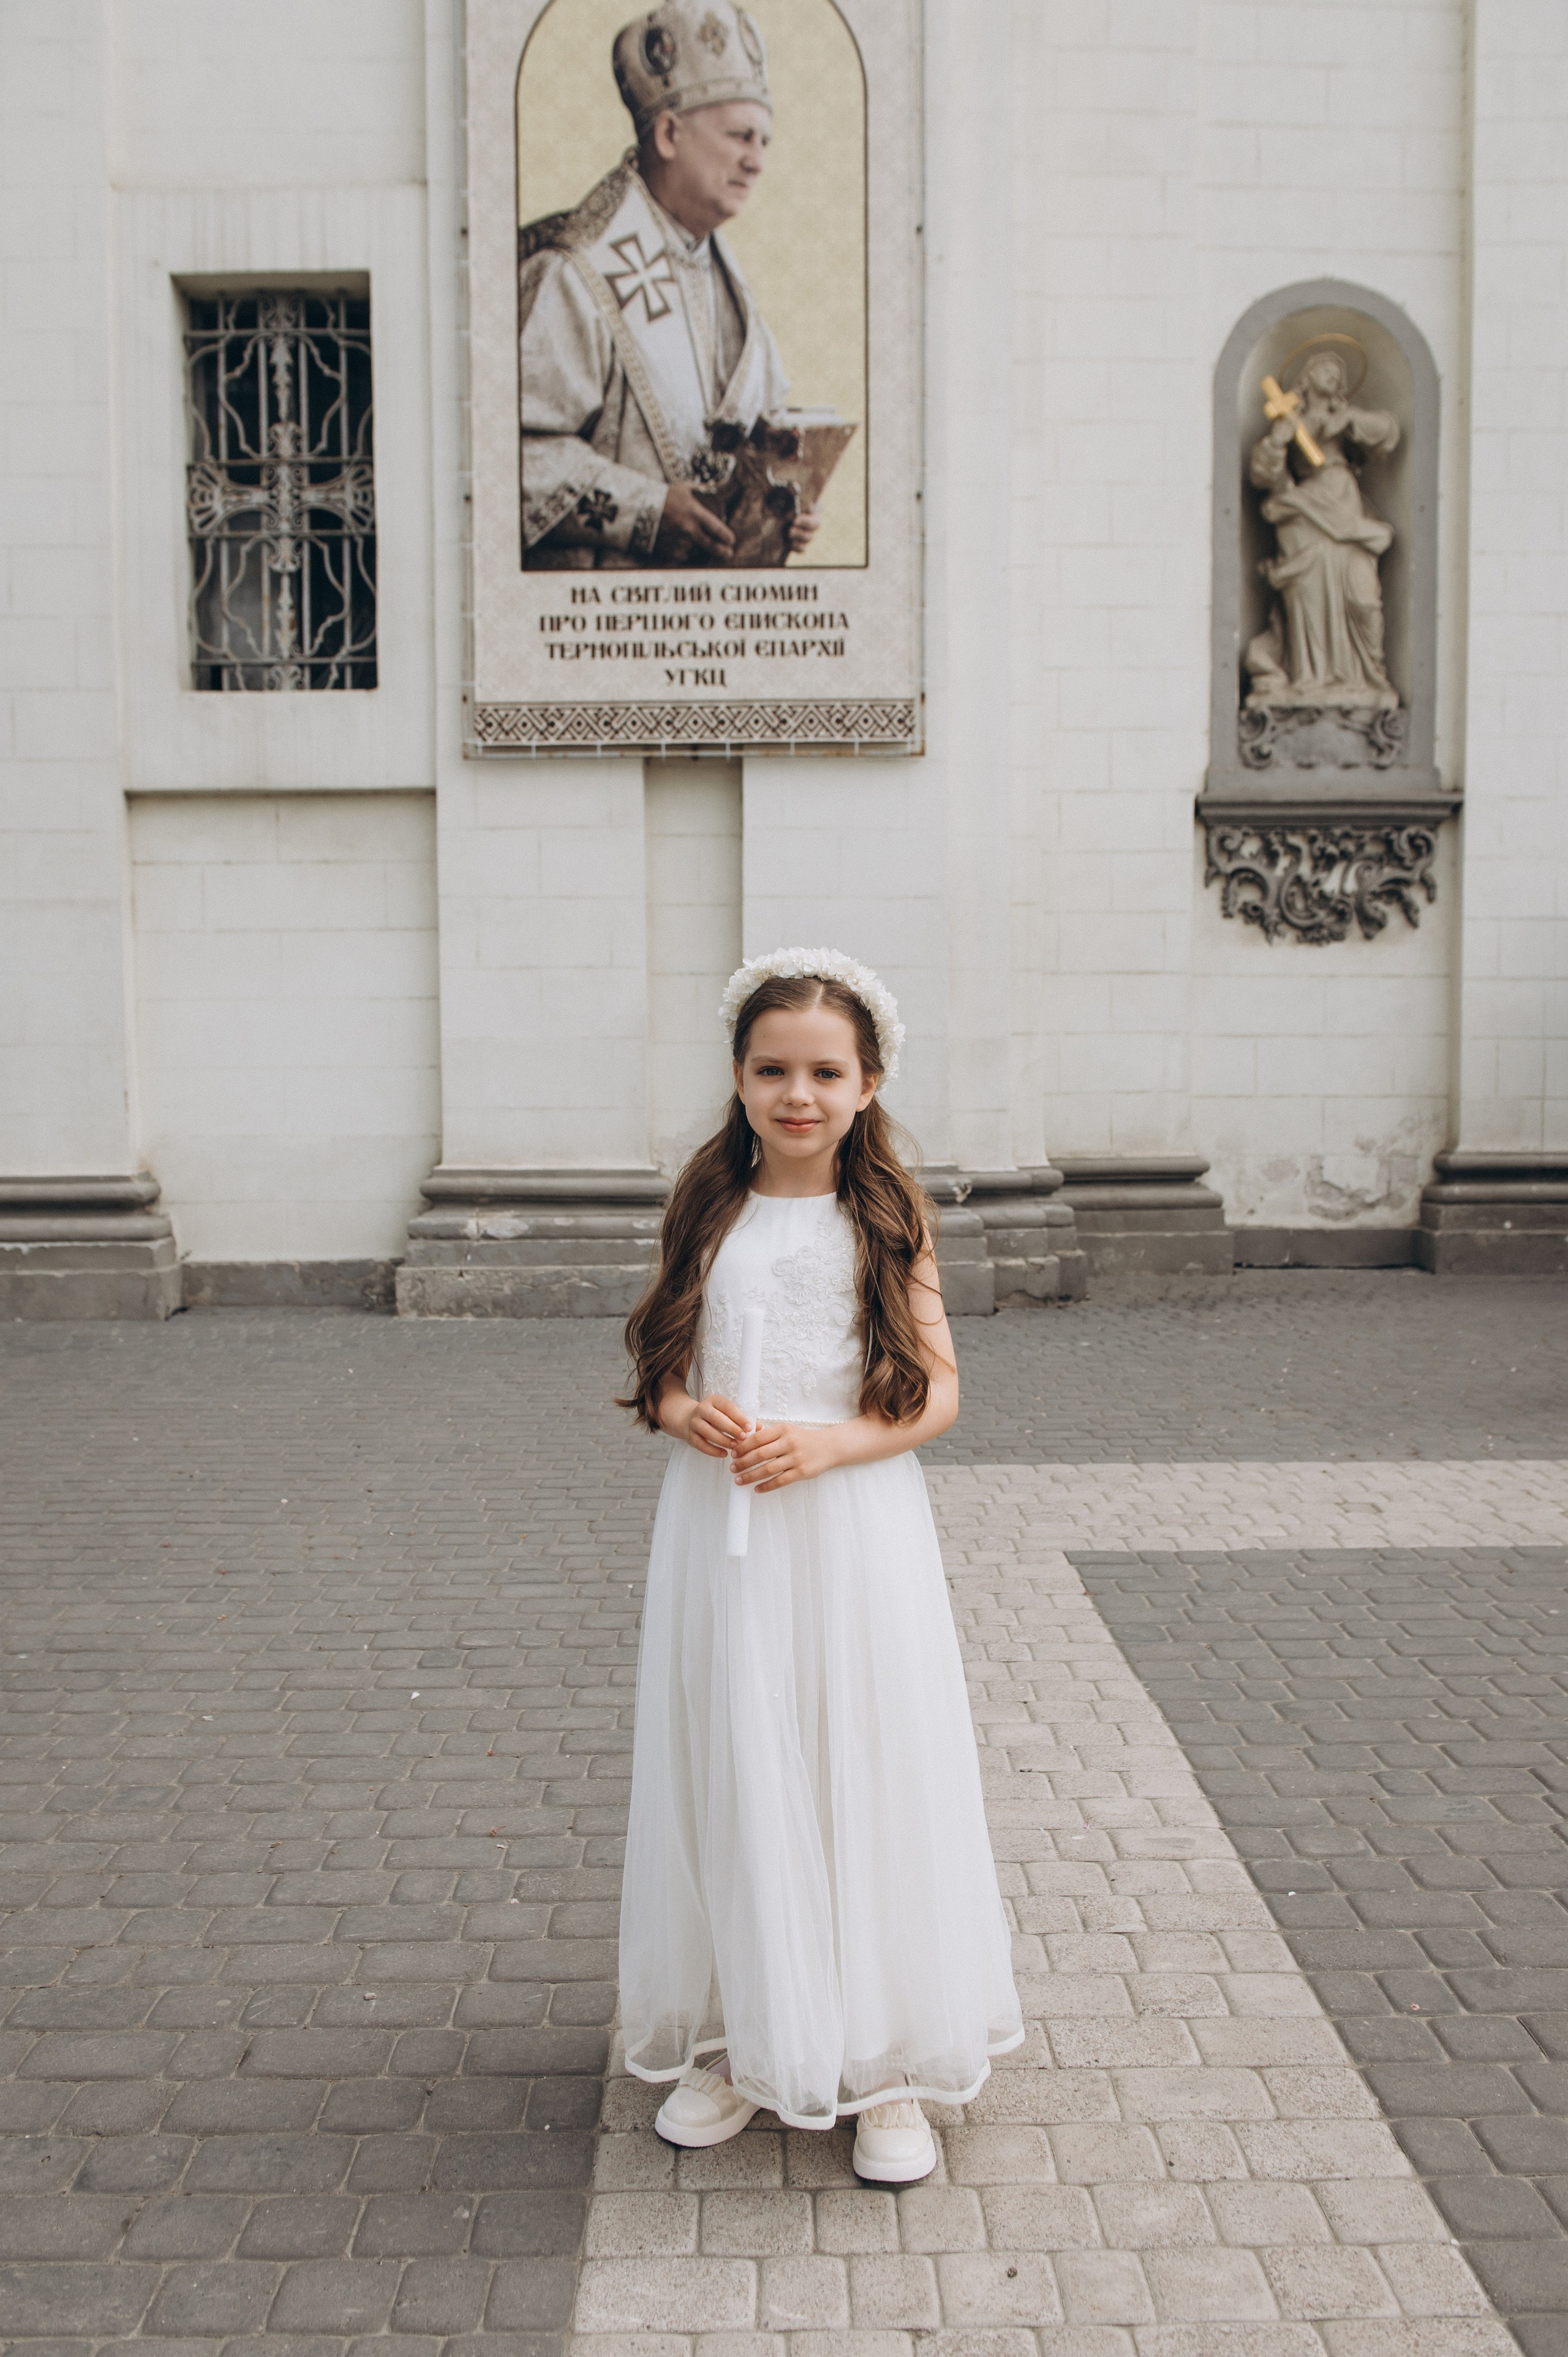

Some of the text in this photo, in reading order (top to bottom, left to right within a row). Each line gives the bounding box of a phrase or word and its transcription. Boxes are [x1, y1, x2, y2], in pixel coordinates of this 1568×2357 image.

[570, 584, 818, 605] НА СВІТЛИЙ СПОМИН
[539, 612, 849, 633] ПРО ПЕРШОГО ЄПИСКОПА
[545, 638, 845, 660] ТЕРНОПІЛЬСЬКОЇ ЄПАРХІЇ
[665, 668, 726, 687] УГКЦ
